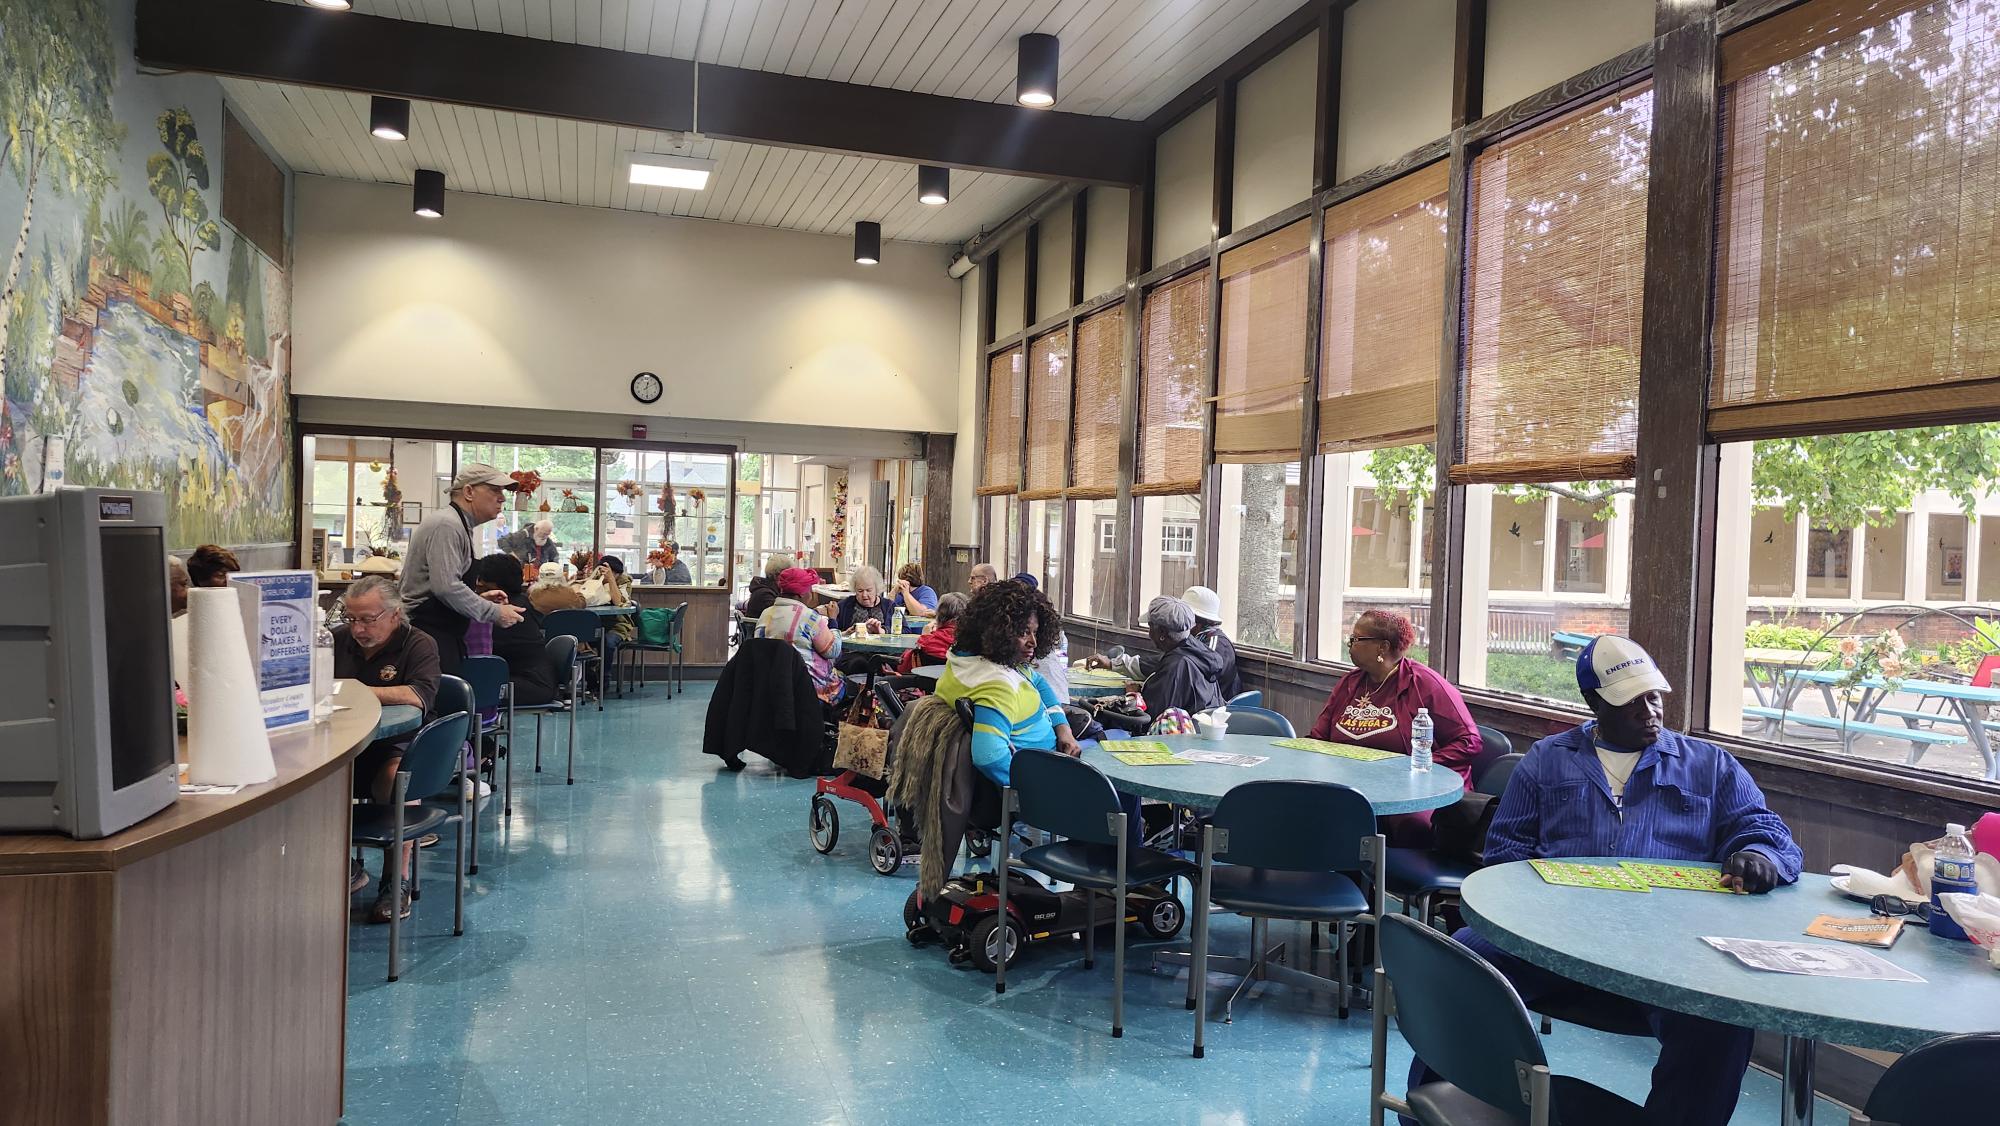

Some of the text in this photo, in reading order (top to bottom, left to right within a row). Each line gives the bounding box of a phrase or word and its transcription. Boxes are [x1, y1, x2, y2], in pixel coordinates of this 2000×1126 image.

[270, 615, 292, 625] EVERY
[270, 625, 298, 636] DOLLAR
[270, 635, 303, 647] MAKES A
[270, 644, 310, 657] DIFFERENCE
[1605, 659, 1645, 675] ENERFLEX
[1339, 719, 1389, 728] LAS VEGAS
